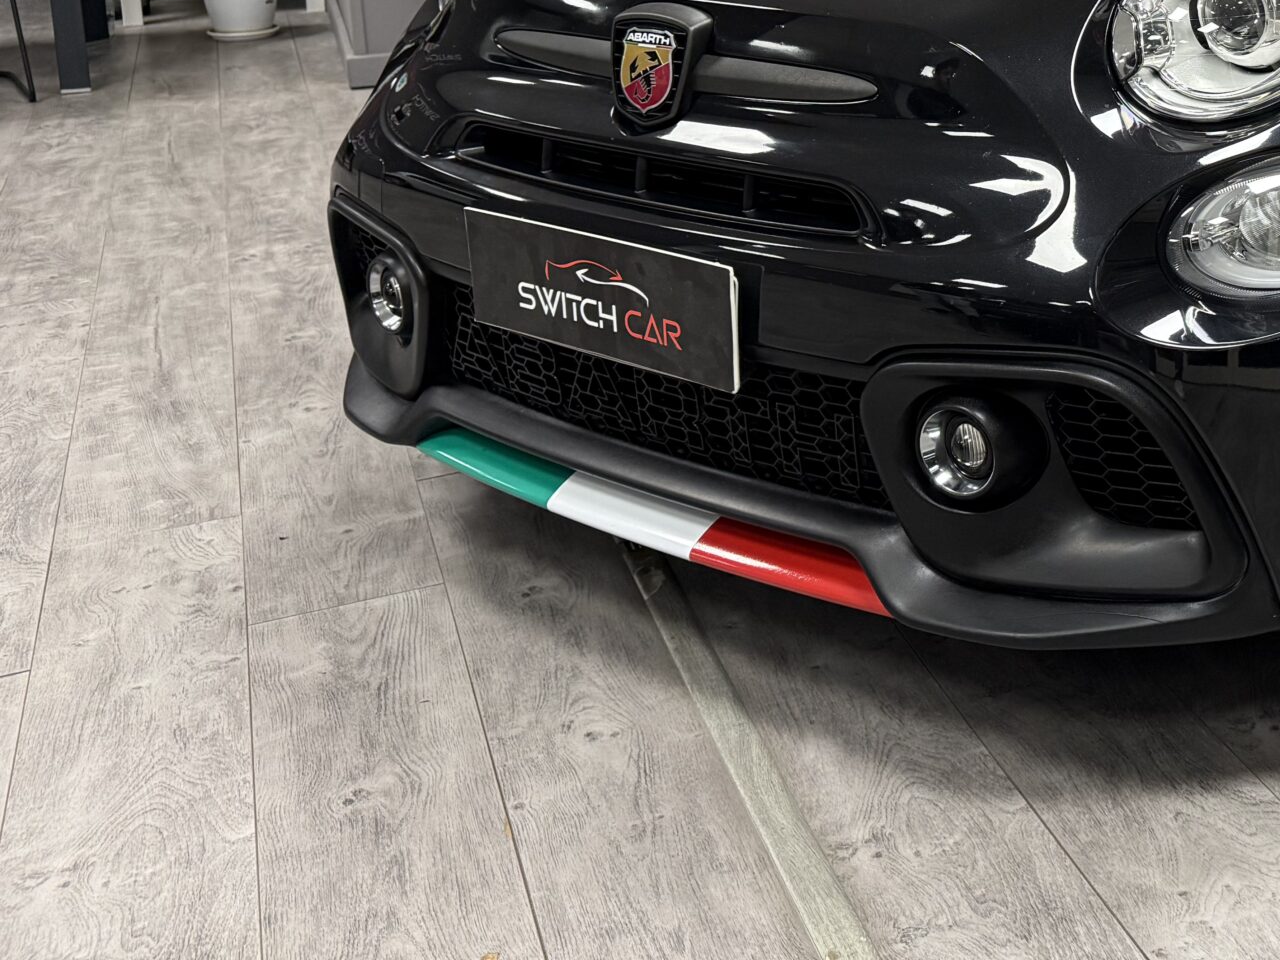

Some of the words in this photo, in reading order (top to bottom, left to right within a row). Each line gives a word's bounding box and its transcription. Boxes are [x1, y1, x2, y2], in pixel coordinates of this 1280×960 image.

[627, 32, 670, 45] ABARTH
[517, 281, 618, 333] SWITCH
[624, 309, 683, 351] CAR
